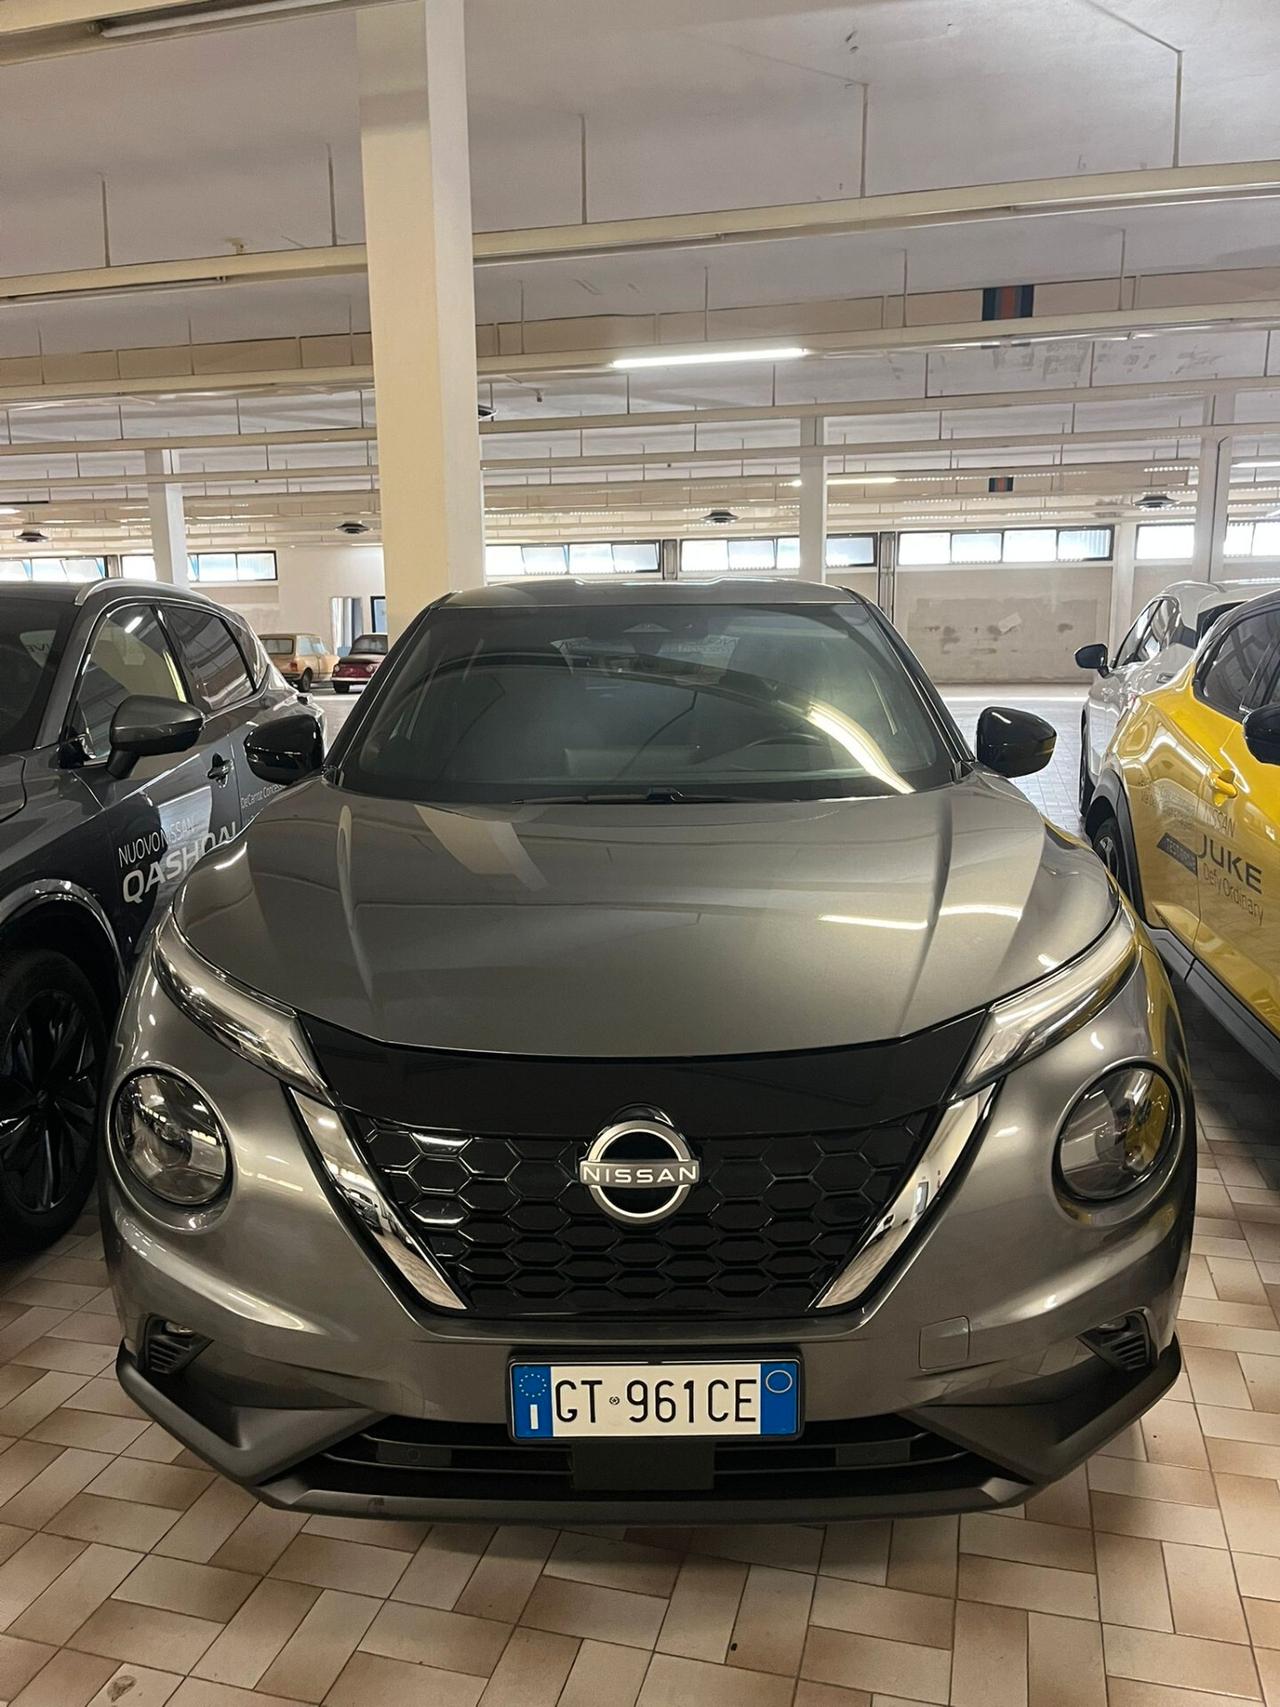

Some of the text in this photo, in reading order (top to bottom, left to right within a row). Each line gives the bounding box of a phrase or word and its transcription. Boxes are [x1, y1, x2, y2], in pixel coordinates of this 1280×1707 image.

[118, 831, 160, 868] NUOVO
[1197, 832, 1262, 895] JUKE
[1203, 862, 1263, 926] Defy Ordinary
[583, 1166, 696, 1183] NISSAN
[529, 1378, 757, 1430] I GT 961CE
